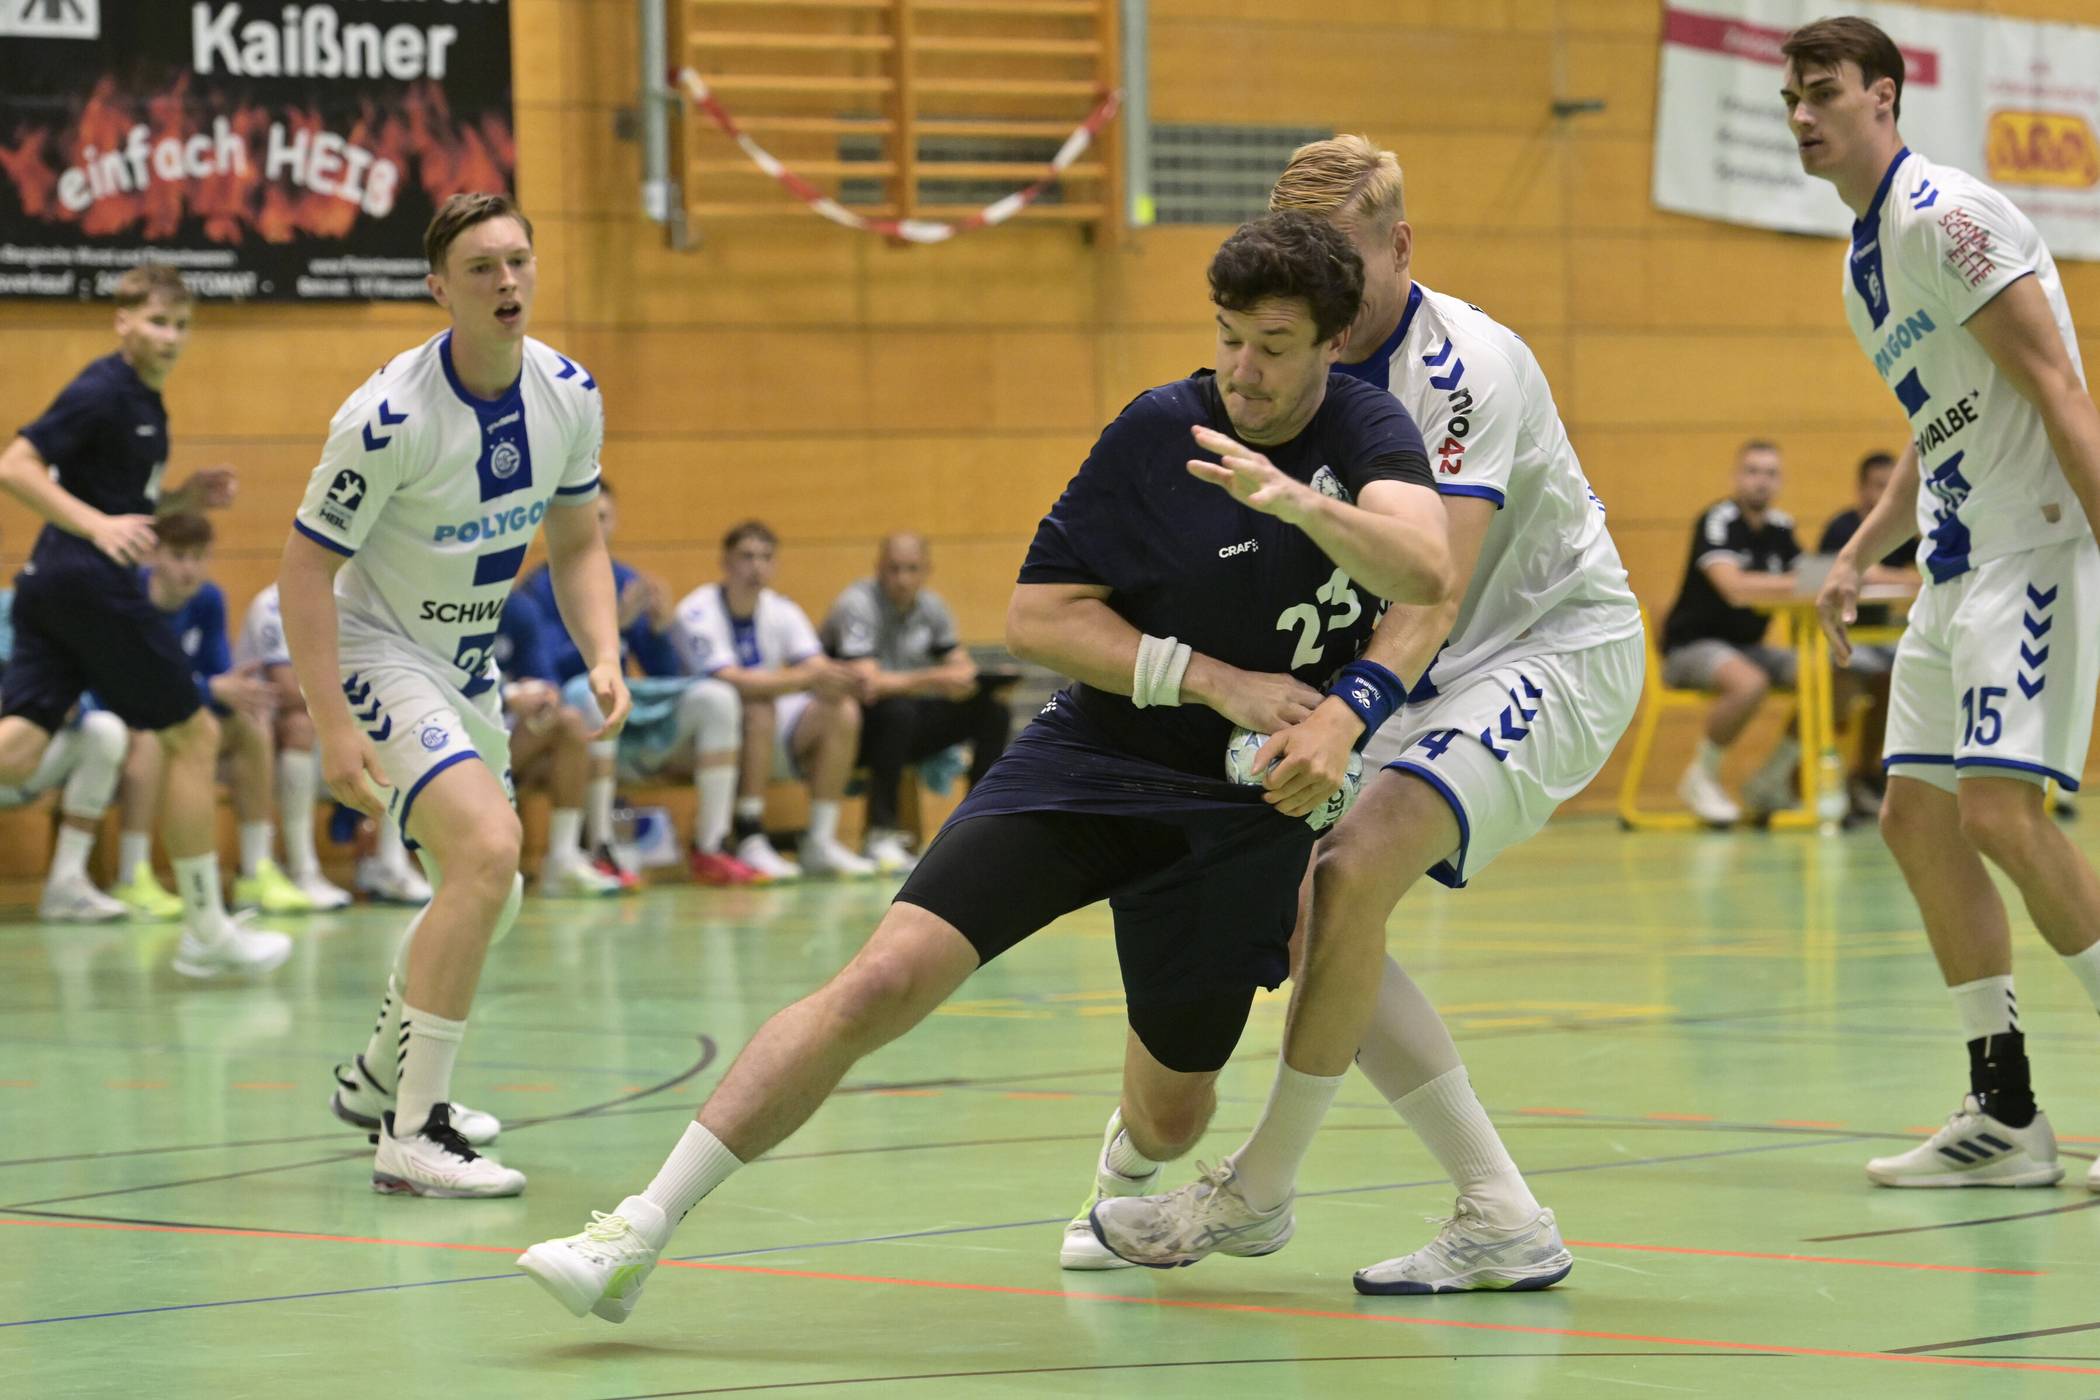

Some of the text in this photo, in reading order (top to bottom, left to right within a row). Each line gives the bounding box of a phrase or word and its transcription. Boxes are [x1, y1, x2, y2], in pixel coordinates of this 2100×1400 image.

[193, 4, 457, 79] Kaißner
[57, 116, 247, 212] einfach
[433, 500, 552, 544] POLYGO
[1276, 567, 1361, 671] 23
[1354, 676, 1381, 701] hummel
[1961, 686, 2008, 747] 15
[1417, 727, 1464, 761] 4
